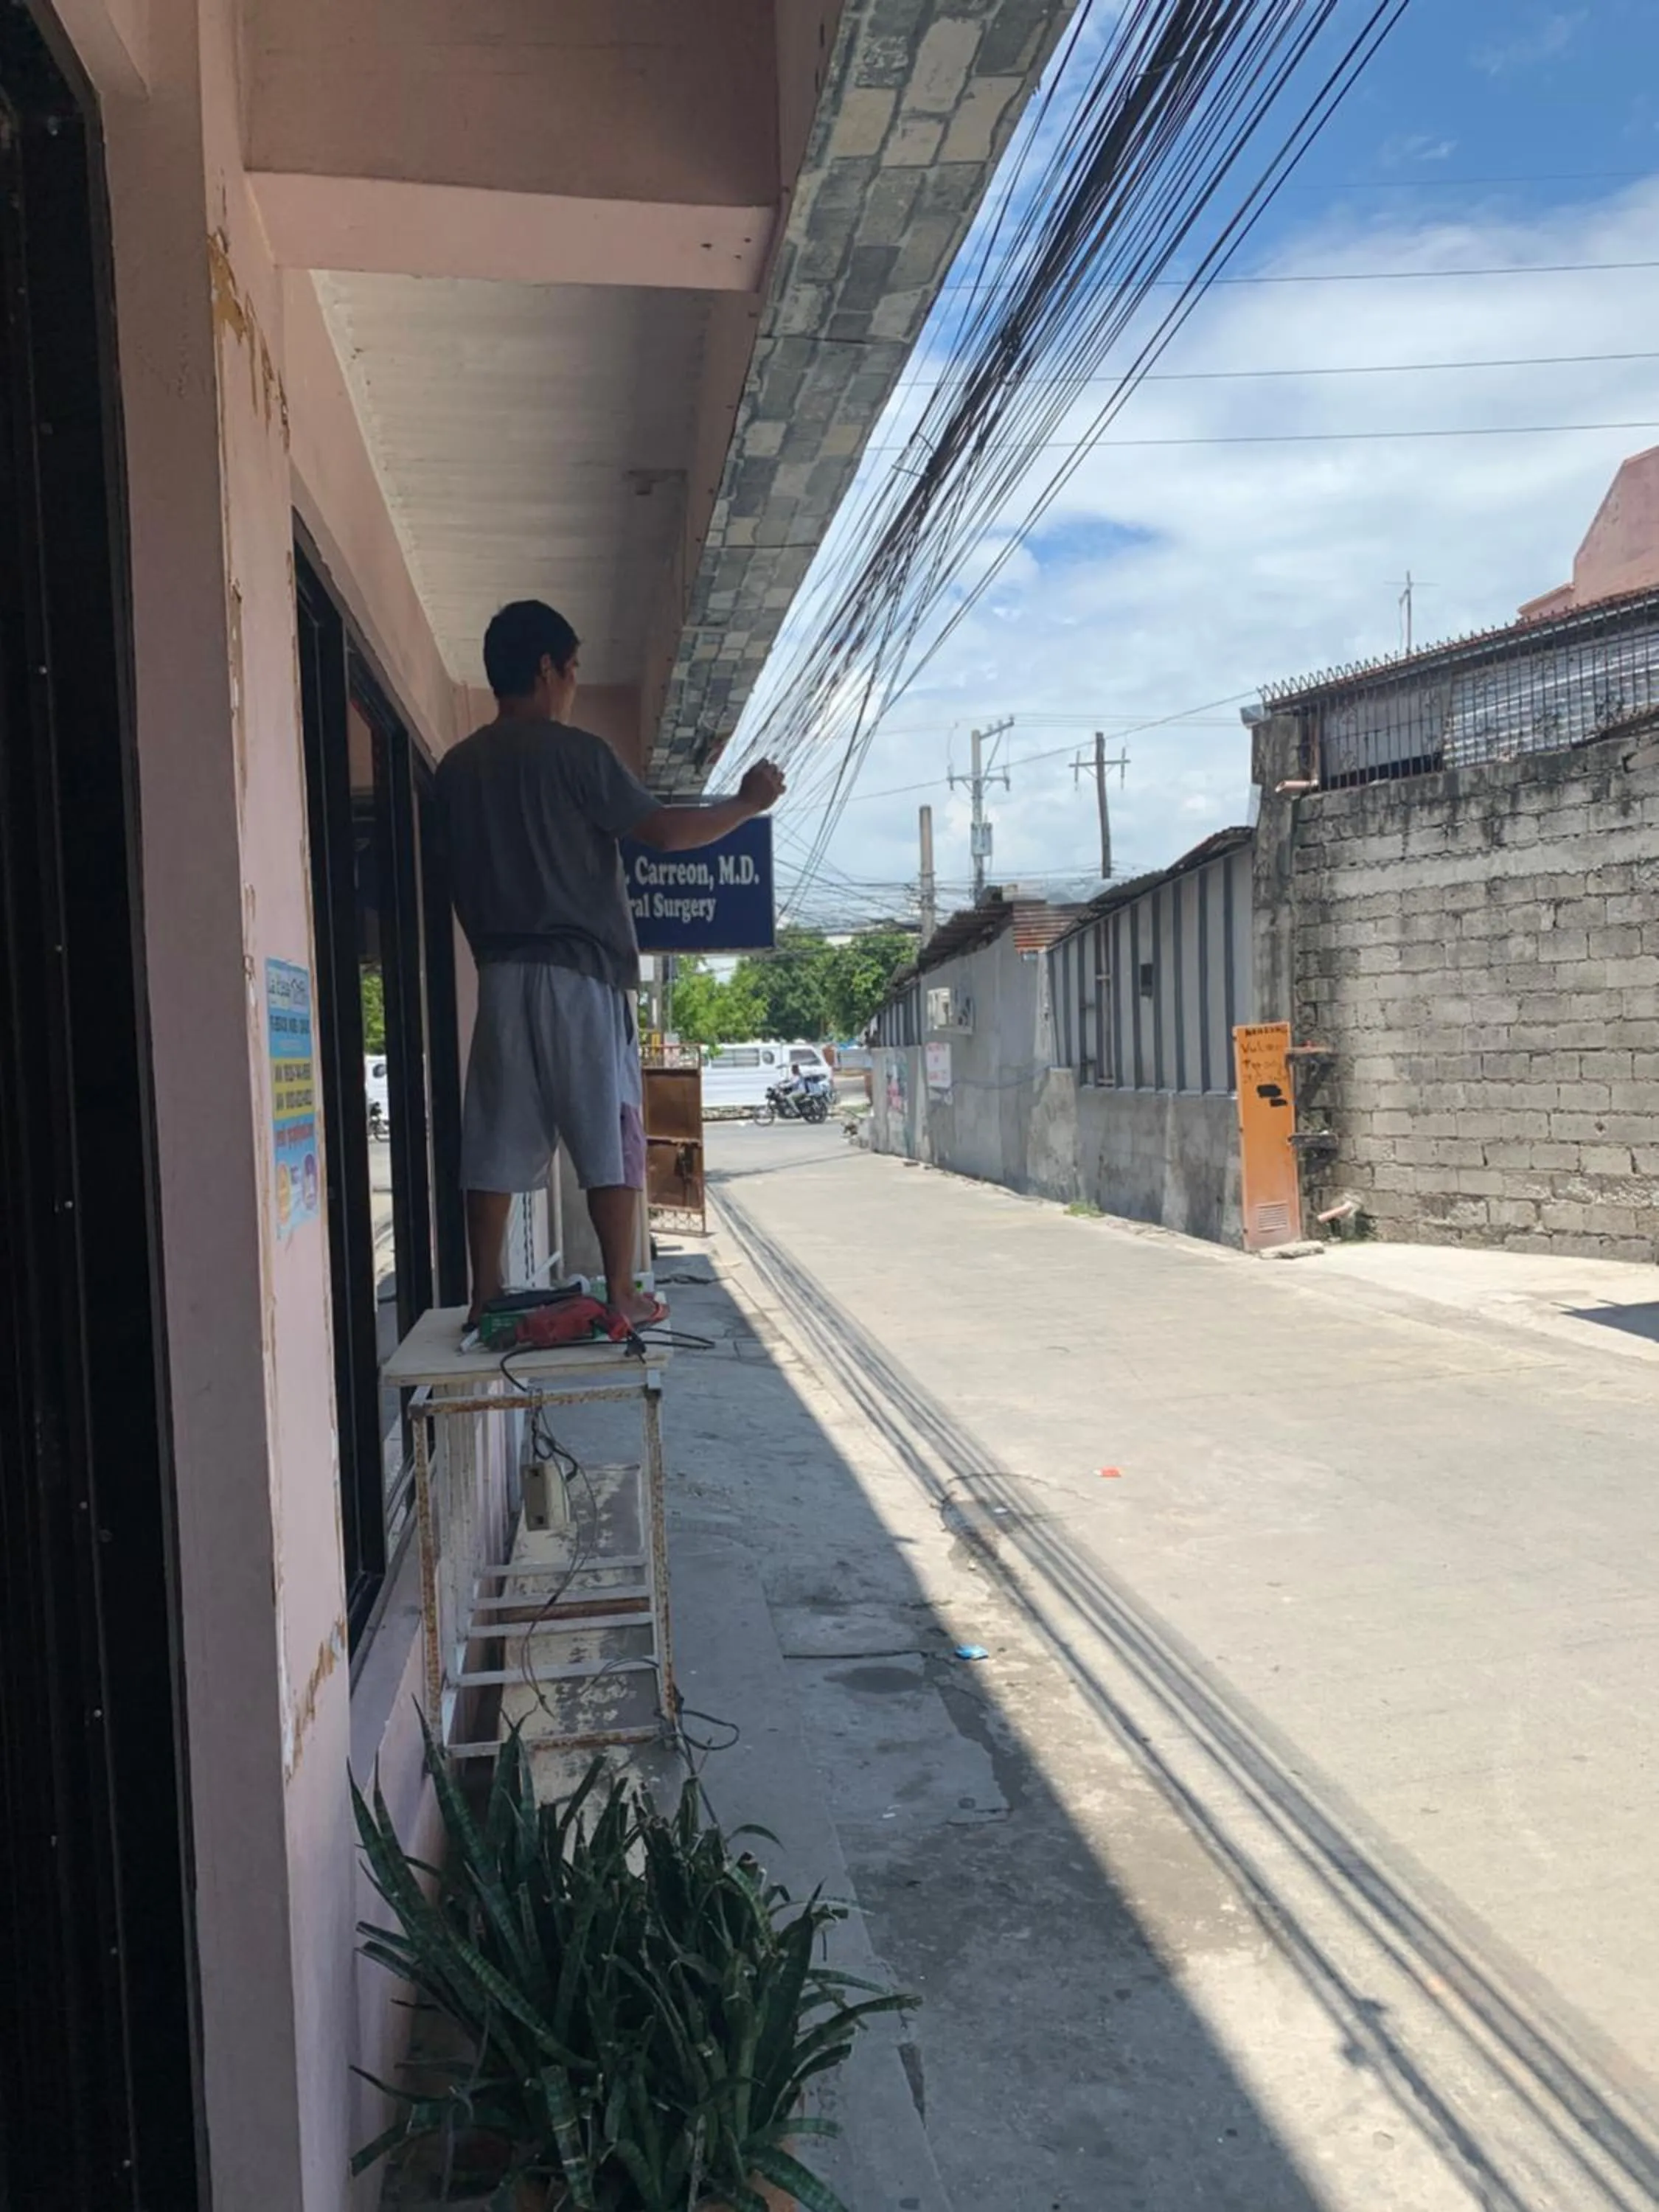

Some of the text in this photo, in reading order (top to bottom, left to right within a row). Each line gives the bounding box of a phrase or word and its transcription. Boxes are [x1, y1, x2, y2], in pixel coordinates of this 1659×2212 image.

[635, 855, 759, 891] Carreon, M.D.
[653, 892, 717, 924] Surgery
